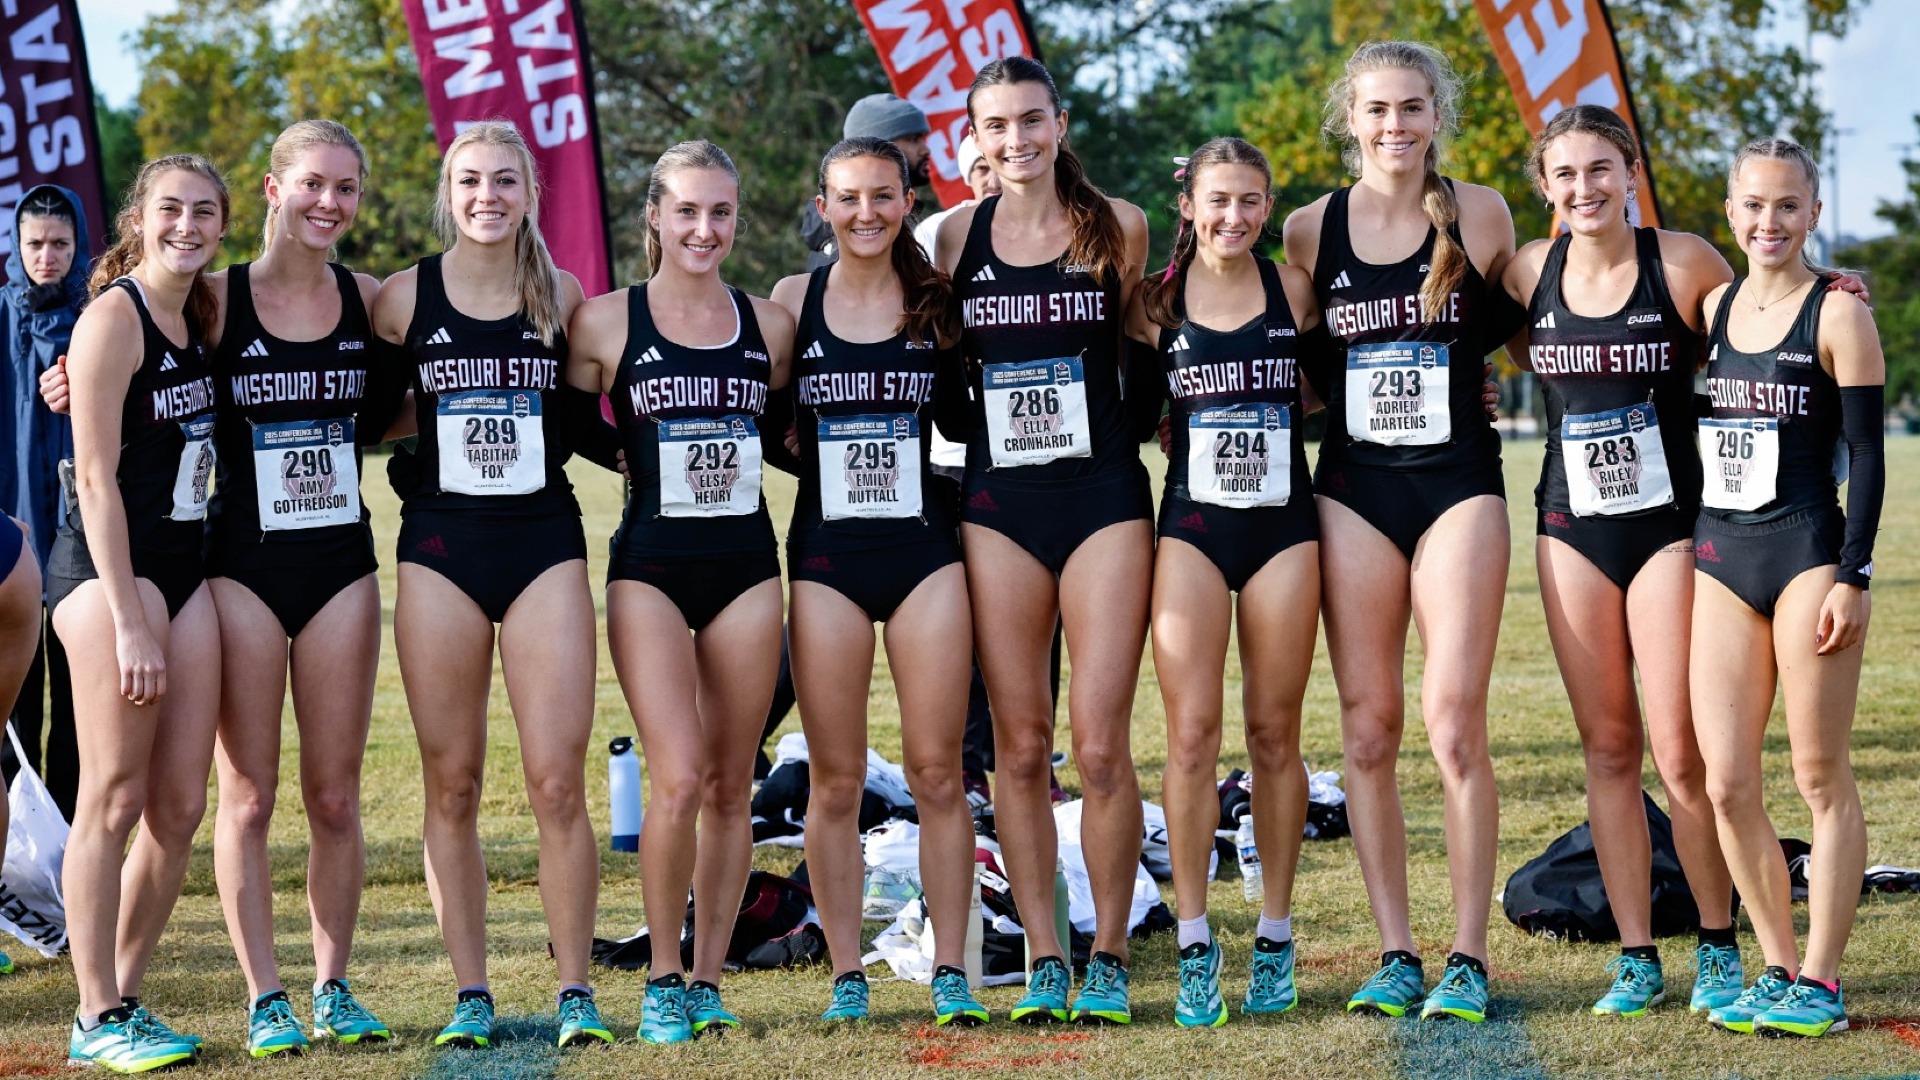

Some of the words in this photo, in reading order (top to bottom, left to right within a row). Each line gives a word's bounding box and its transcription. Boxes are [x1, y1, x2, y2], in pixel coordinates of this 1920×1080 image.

[962, 294, 1041, 328] MISSOURI
[1048, 291, 1105, 322] STATE
[1325, 297, 1398, 338] MISSOURI
[1404, 292, 1460, 325] STE
[1610, 341, 1671, 373] STATE
[231, 370, 317, 405] MISSOURI
[324, 369, 366, 400] STATE
[418, 358, 501, 393] MISSOURI
[508, 357, 558, 390] STATE
[1166, 361, 1245, 399] MISSOURI
[1252, 358, 1296, 390] STATE
[1372, 370, 1421, 398] 293
[629, 376, 719, 415] MISSOURI
[727, 378, 768, 415] STATE
[798, 373, 875, 405] MISSOURI
[884, 372, 935, 403] STATE
[1756, 386, 1811, 416] STATE
[1009, 387, 1060, 418] 286
[1375, 400, 1419, 415] ADRIEN
[465, 417, 516, 445] 289
[1023, 418, 1051, 435] ELLA
[1370, 415, 1427, 431] MARTENS
[467, 448, 518, 462] TABITHA
[1004, 433, 1075, 452] CRONHARDT
[1216, 430, 1267, 459] 294
[1584, 435, 1637, 469] 283
[1716, 429, 1755, 460] 296
[283, 447, 333, 479] 290
[687, 440, 739, 472] 292
[846, 441, 897, 470] 295
[481, 464, 504, 479] FOX
[699, 473, 728, 488] ELSA
[855, 471, 890, 487] EMILY
[1215, 462, 1268, 476] MADILYN
[1599, 466, 1632, 484] RILEY
[1724, 462, 1742, 477] ELLA
[299, 480, 325, 495] AMY
[694, 488, 732, 505] HENRY
[847, 488, 899, 504] NUTTALL
[1220, 478, 1262, 493] MOORE
[1599, 482, 1640, 501] BRYAN
[1724, 479, 1742, 494] REW
[273, 493, 348, 515] GOTFREDSON
